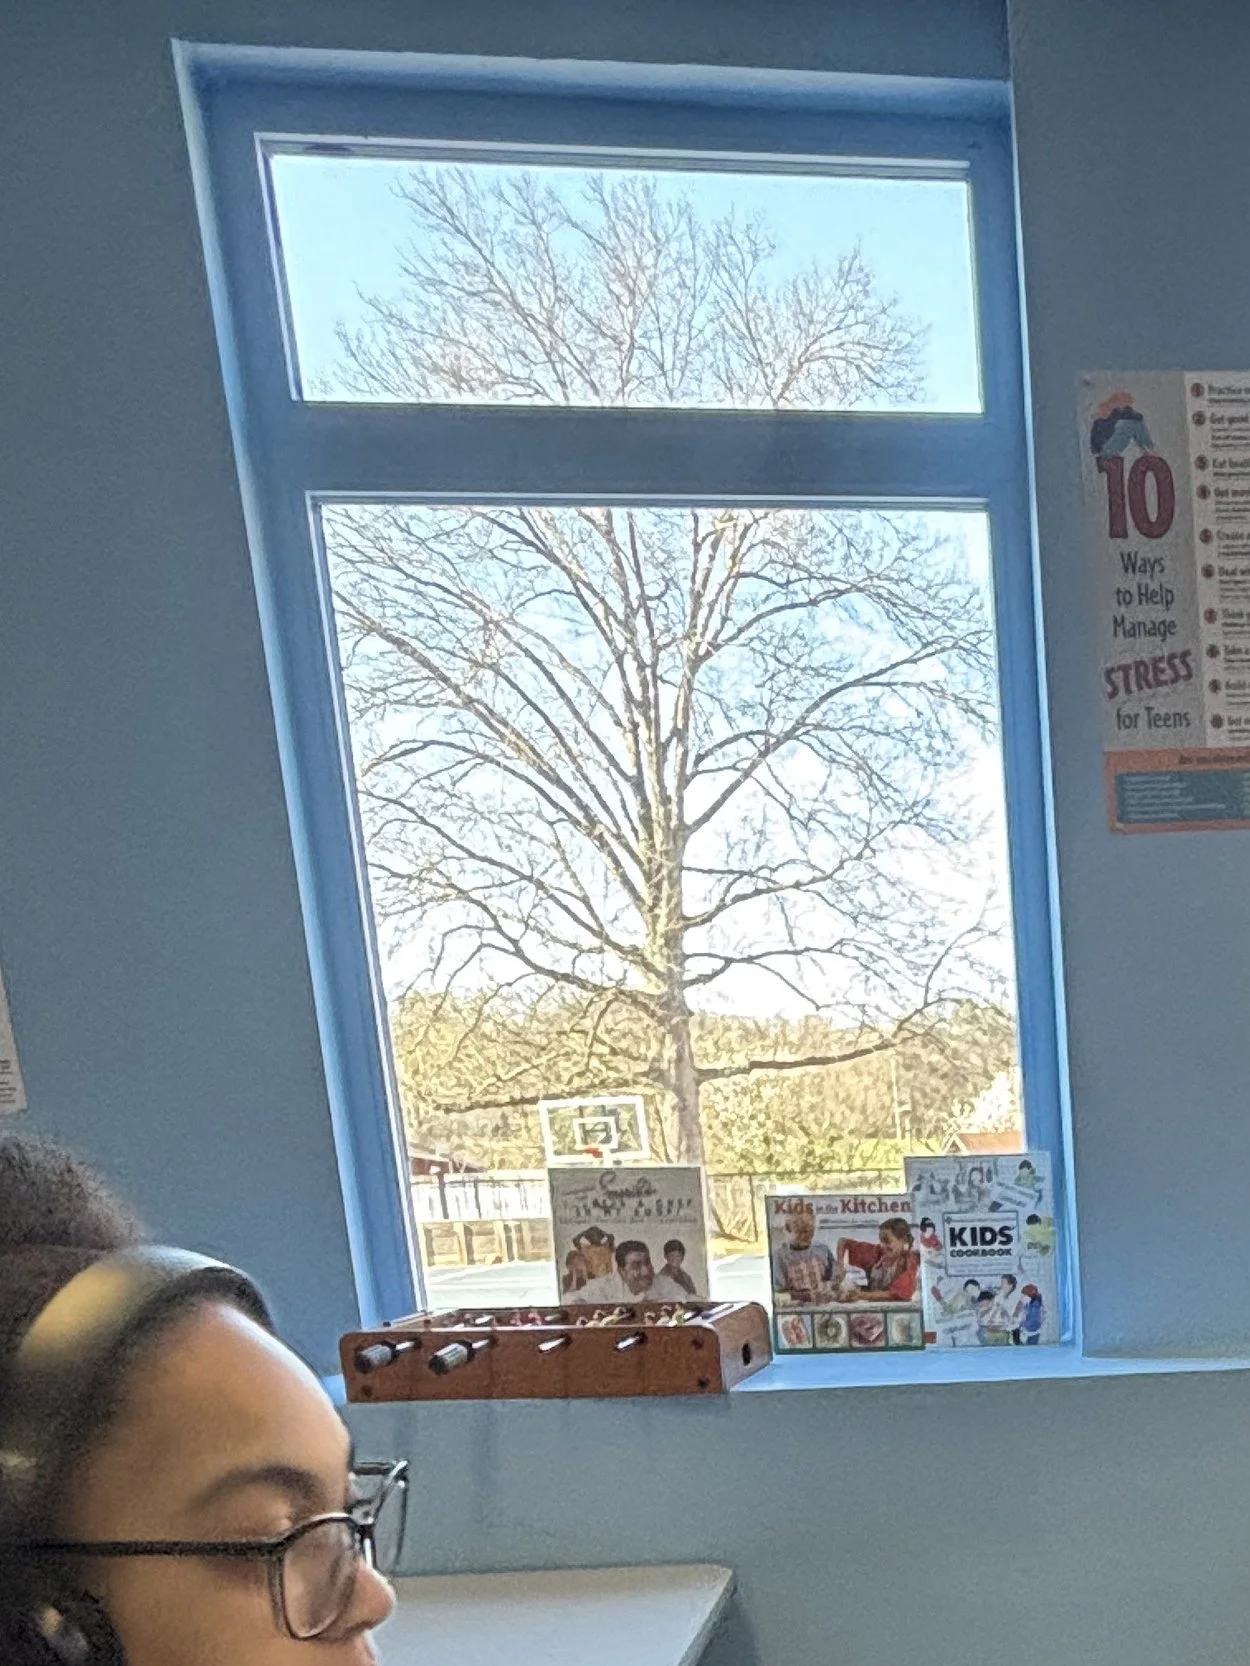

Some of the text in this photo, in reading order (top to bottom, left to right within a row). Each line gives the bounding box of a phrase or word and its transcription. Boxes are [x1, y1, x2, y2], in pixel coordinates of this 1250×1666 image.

[1096, 455, 1175, 539] 10
[1120, 550, 1166, 580] Ways
[1116, 582, 1175, 611] to Help
[1113, 614, 1177, 642] Manage
[1104, 648, 1193, 700] STRESS
[1116, 706, 1191, 731] for Teens
[774, 1197, 814, 1214] Kids
[841, 1196, 912, 1213] Kitchen
